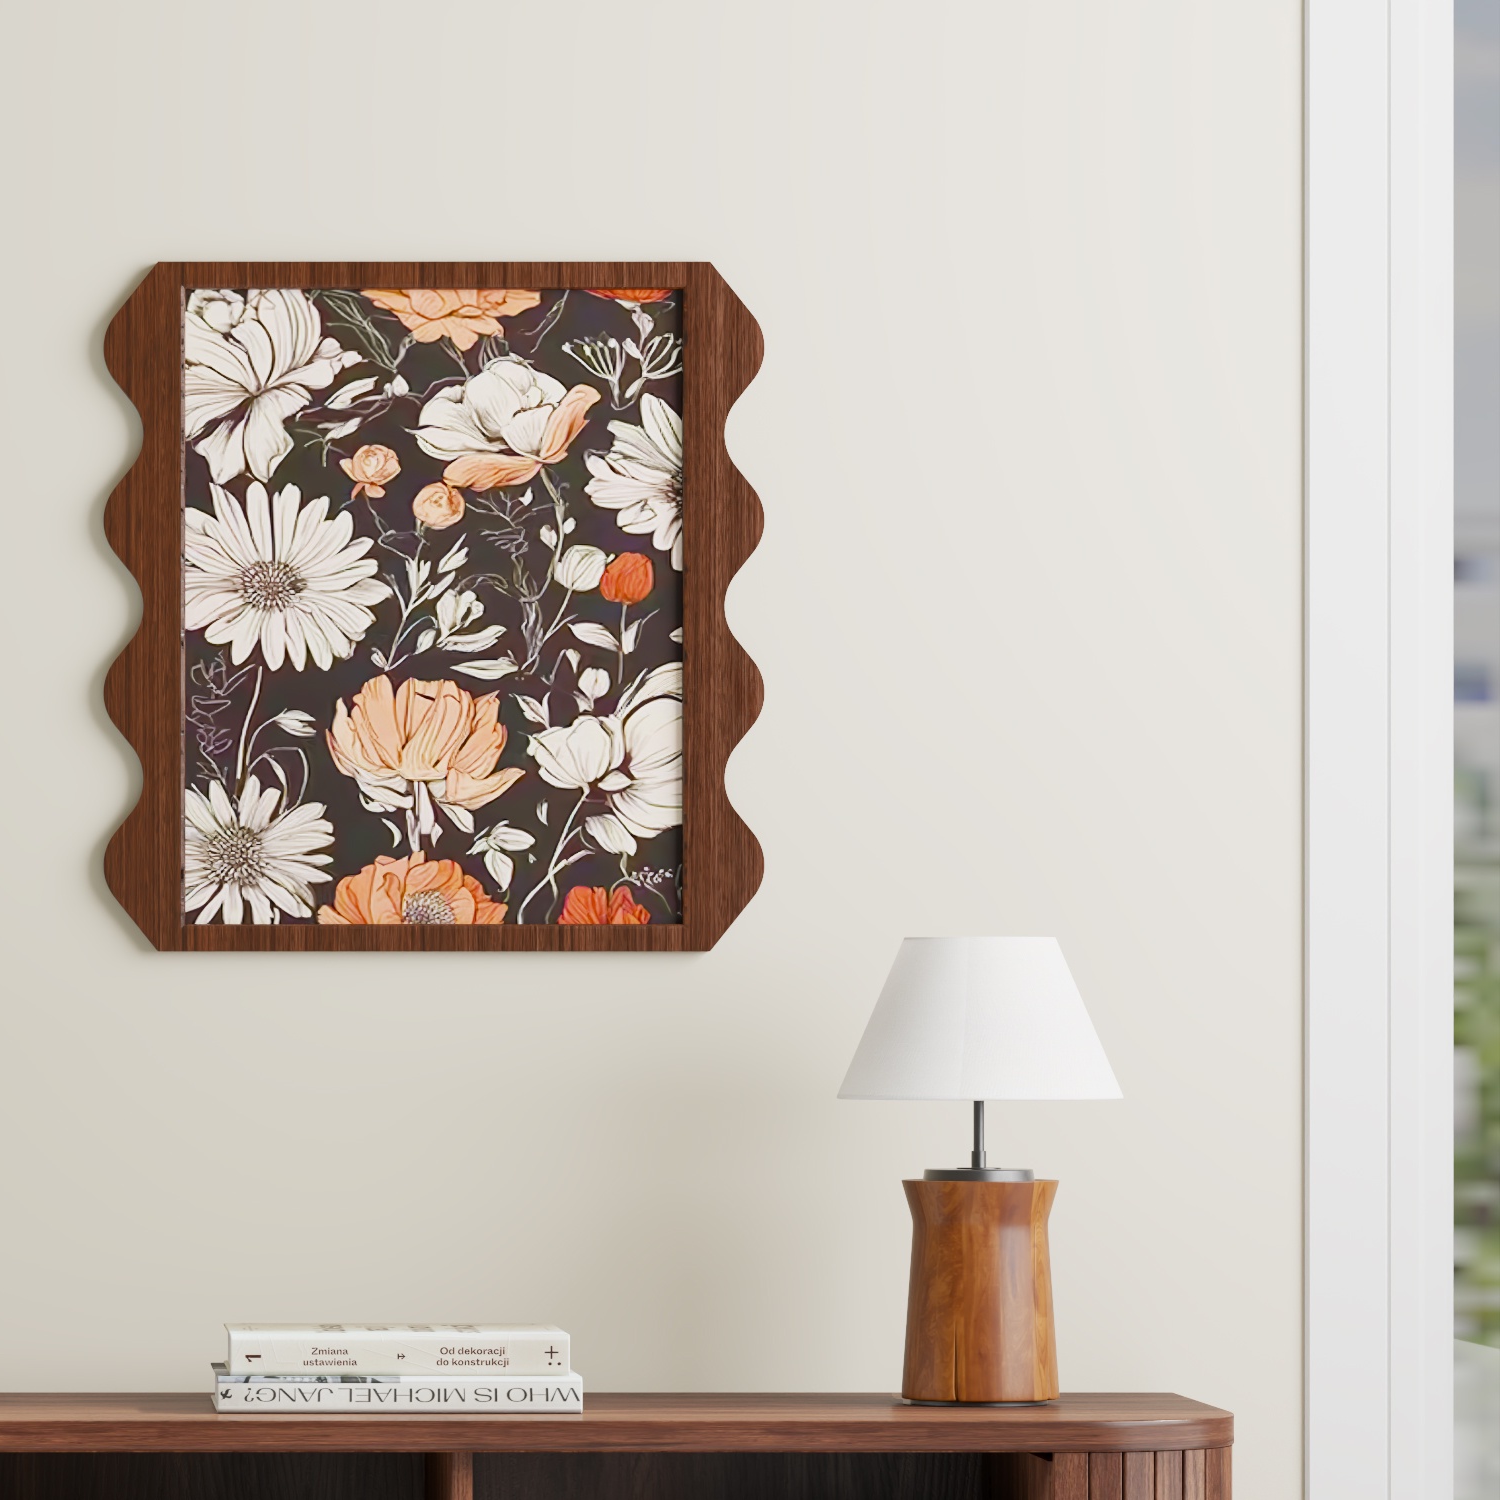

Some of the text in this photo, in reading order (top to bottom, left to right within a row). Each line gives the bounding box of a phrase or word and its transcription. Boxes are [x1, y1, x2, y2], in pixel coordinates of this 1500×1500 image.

[311, 1347, 348, 1355] Zmiana
[439, 1346, 506, 1357] Od dekoracji
[303, 1358, 357, 1366] ustawienia
[436, 1357, 510, 1367] do konstrukcji
[244, 1387, 580, 1403] WHO IS MICHAEL JANG?
